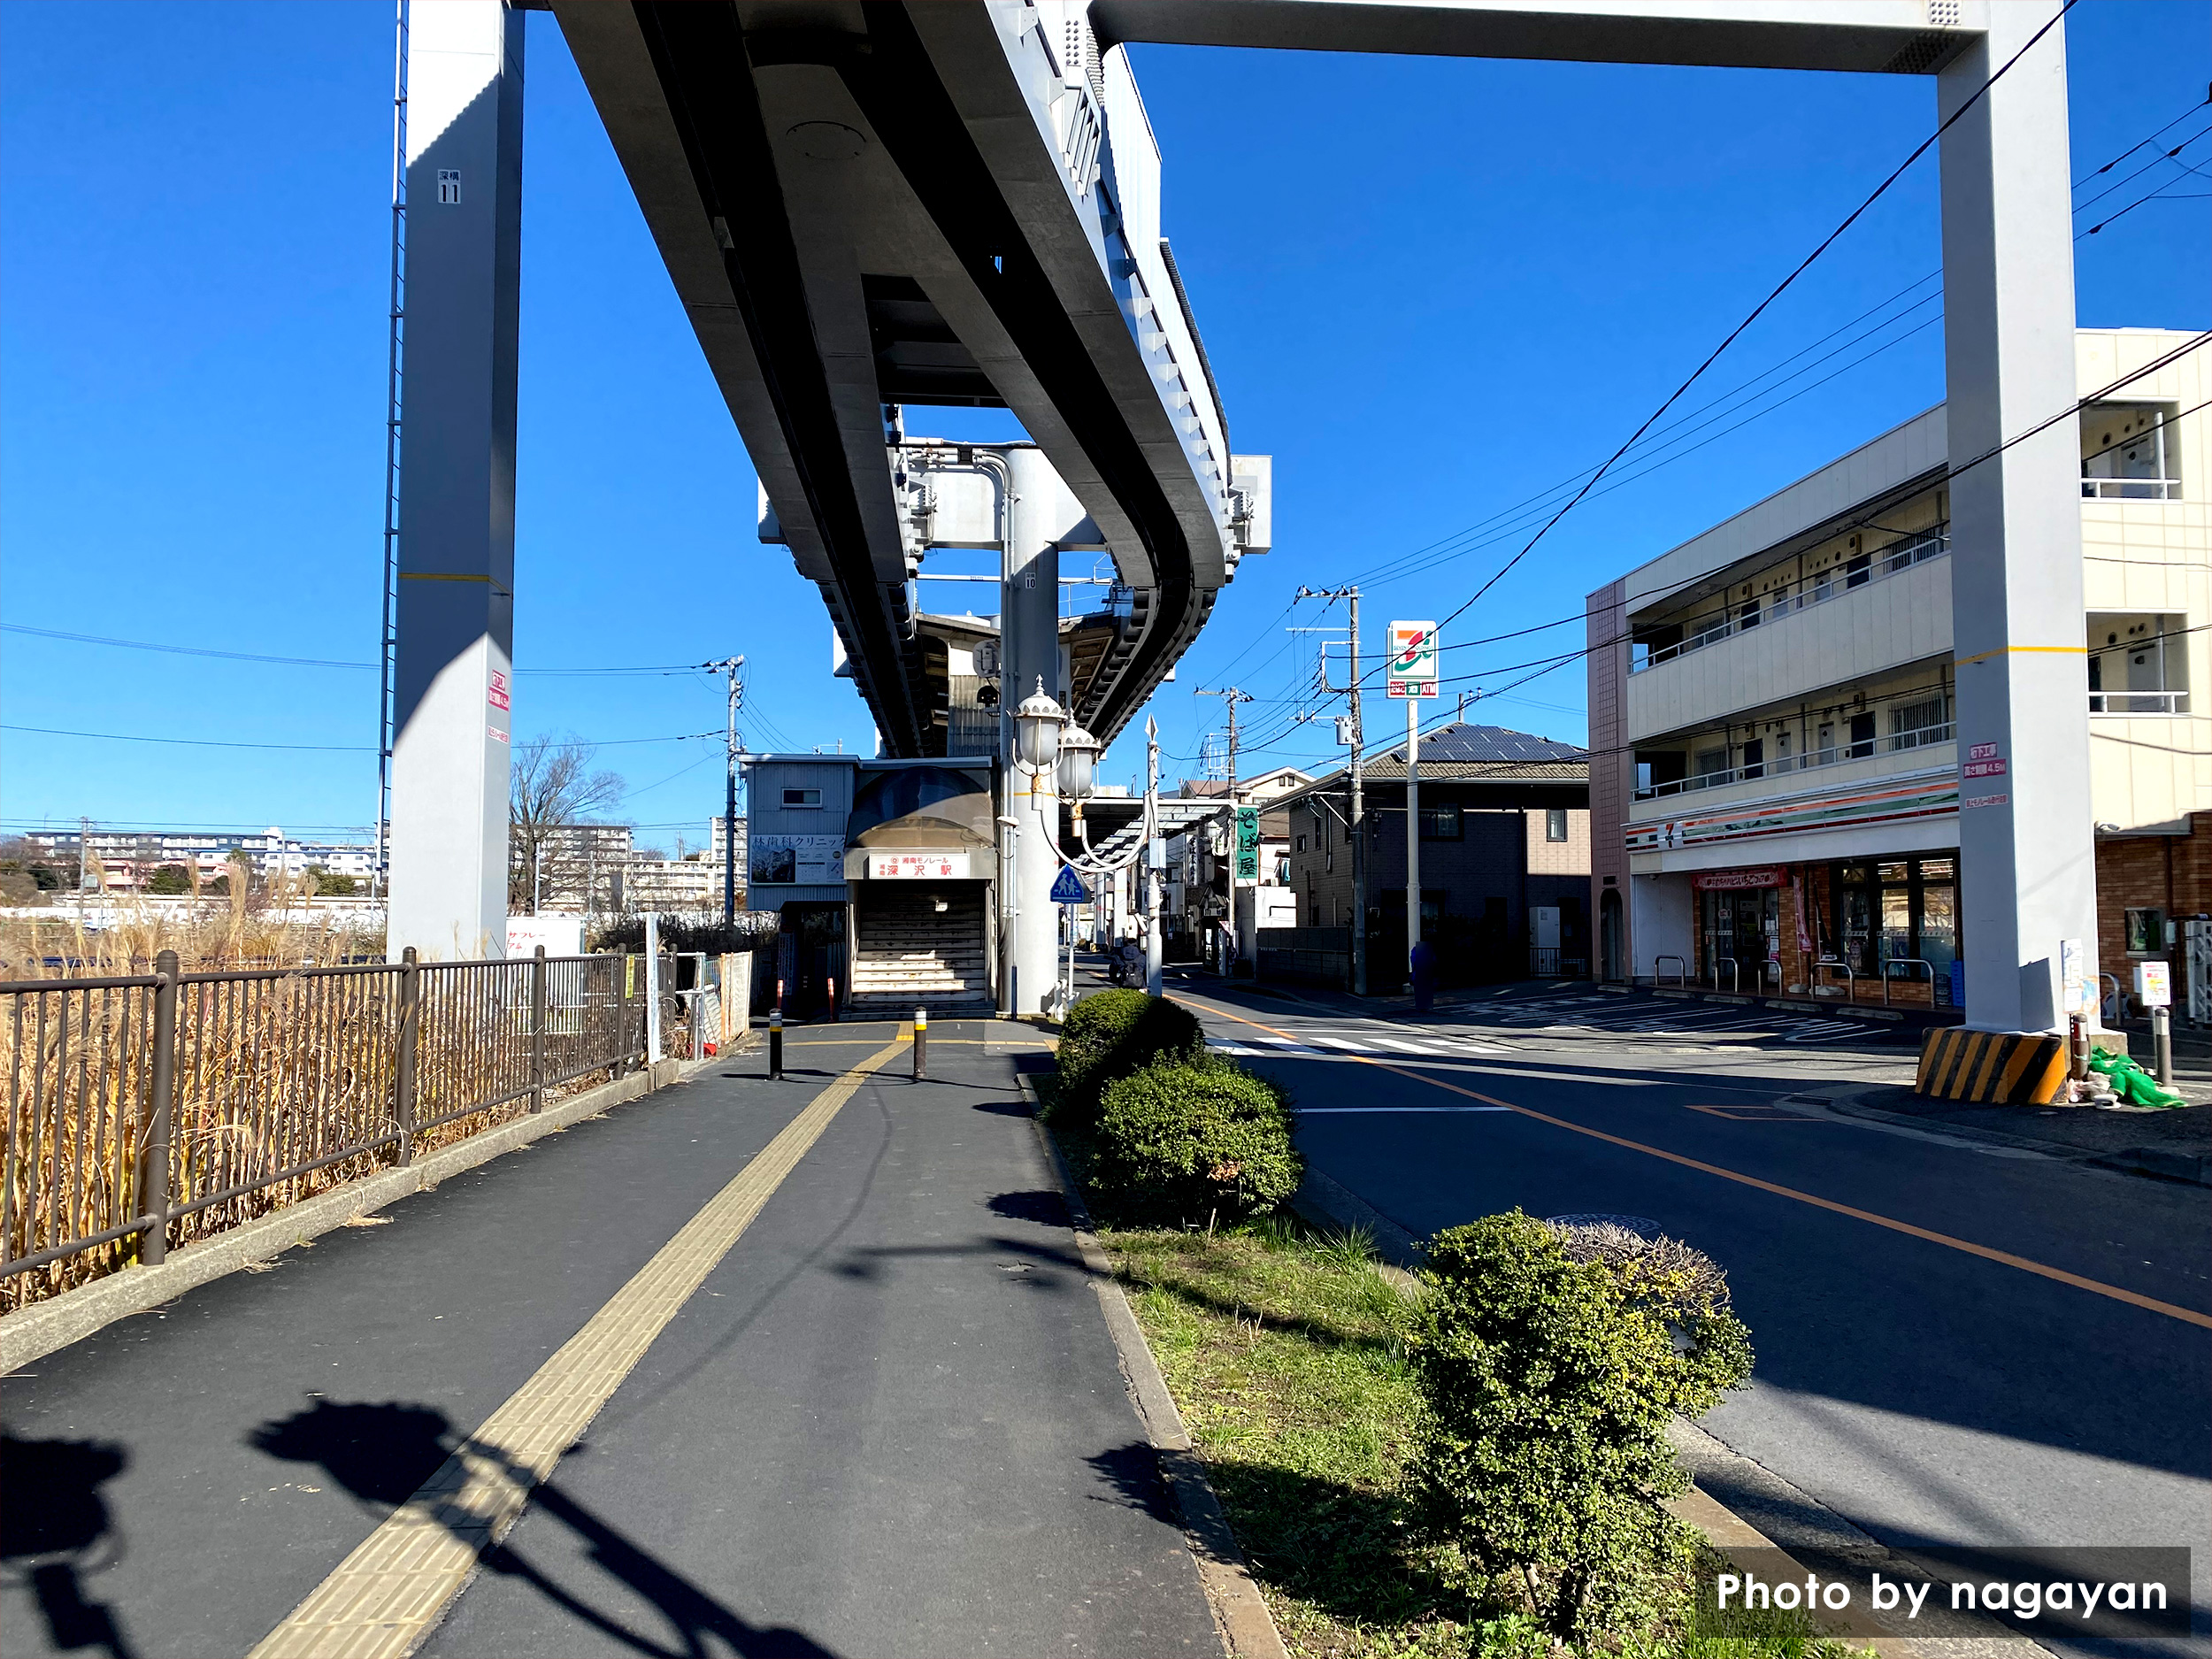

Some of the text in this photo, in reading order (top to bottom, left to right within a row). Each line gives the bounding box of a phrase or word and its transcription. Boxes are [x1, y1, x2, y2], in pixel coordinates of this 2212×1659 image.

[441, 184, 457, 203] 11
[1026, 579, 1035, 588] 10
[1422, 682, 1436, 694] ATM
[1239, 810, 1258, 875] そば屋
[887, 864, 953, 876] 深沢駅
